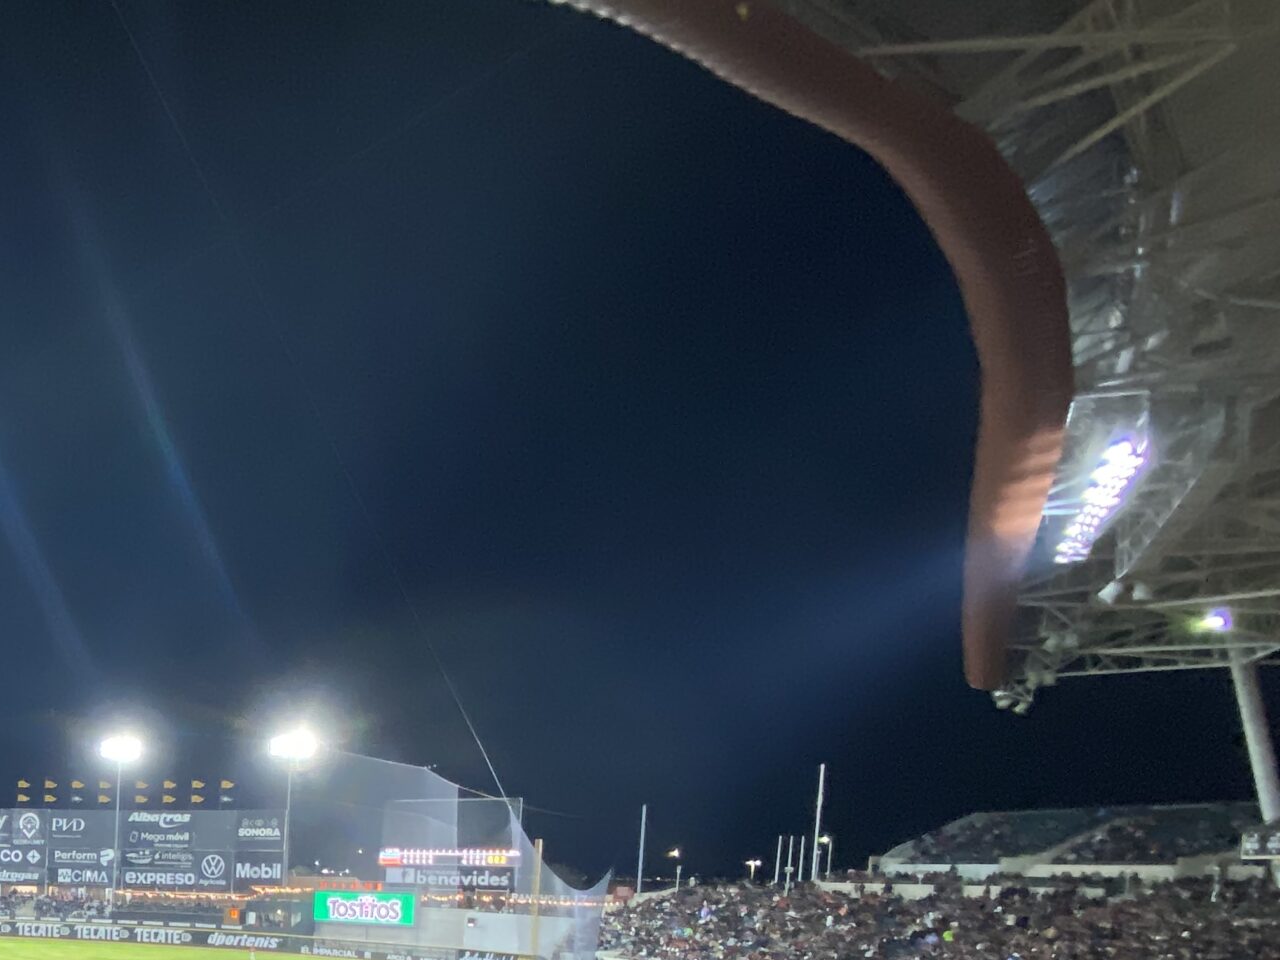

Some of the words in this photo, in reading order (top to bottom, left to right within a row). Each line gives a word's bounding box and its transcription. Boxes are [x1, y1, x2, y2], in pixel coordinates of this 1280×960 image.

[128, 811, 191, 824] Albatros
[140, 832, 166, 843] Mega
[238, 827, 281, 837] SONORA
[54, 850, 97, 860] Perform
[71, 869, 109, 883] CIMA
[235, 863, 282, 879] Mobil
[416, 869, 509, 886] benavides
[16, 922, 61, 938] TECATE
[74, 924, 121, 941] TECATE
[134, 927, 183, 944] TECATE
[207, 931, 278, 949] dportenis
